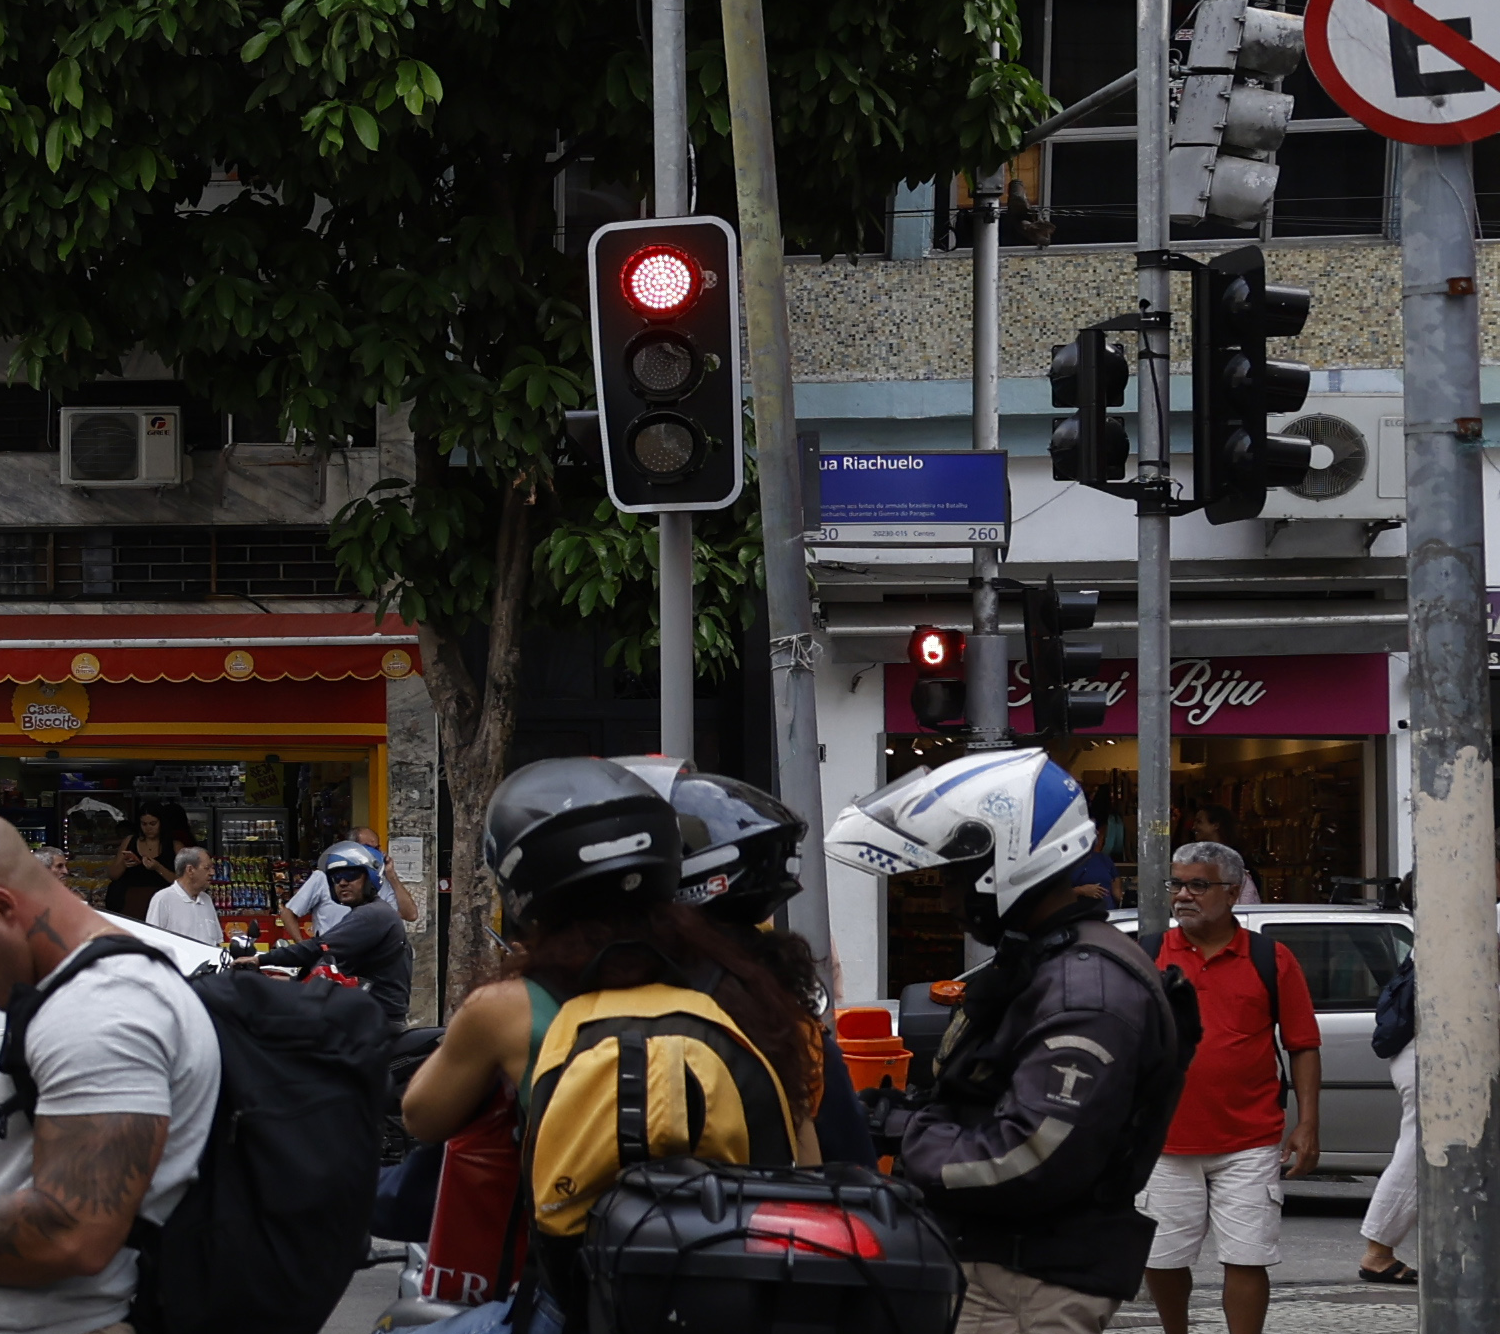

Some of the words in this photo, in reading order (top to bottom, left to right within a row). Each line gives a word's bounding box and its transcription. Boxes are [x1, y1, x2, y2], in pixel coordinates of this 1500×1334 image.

[1385, 419, 1404, 427] ELG
[818, 460, 838, 471] ua
[843, 455, 924, 471] Riachuelo
[812, 527, 838, 541] 30
[968, 527, 998, 541] 260
[1170, 659, 1267, 725] Biju
[27, 703, 58, 716] Casa
[21, 714, 80, 730] Biscoito
